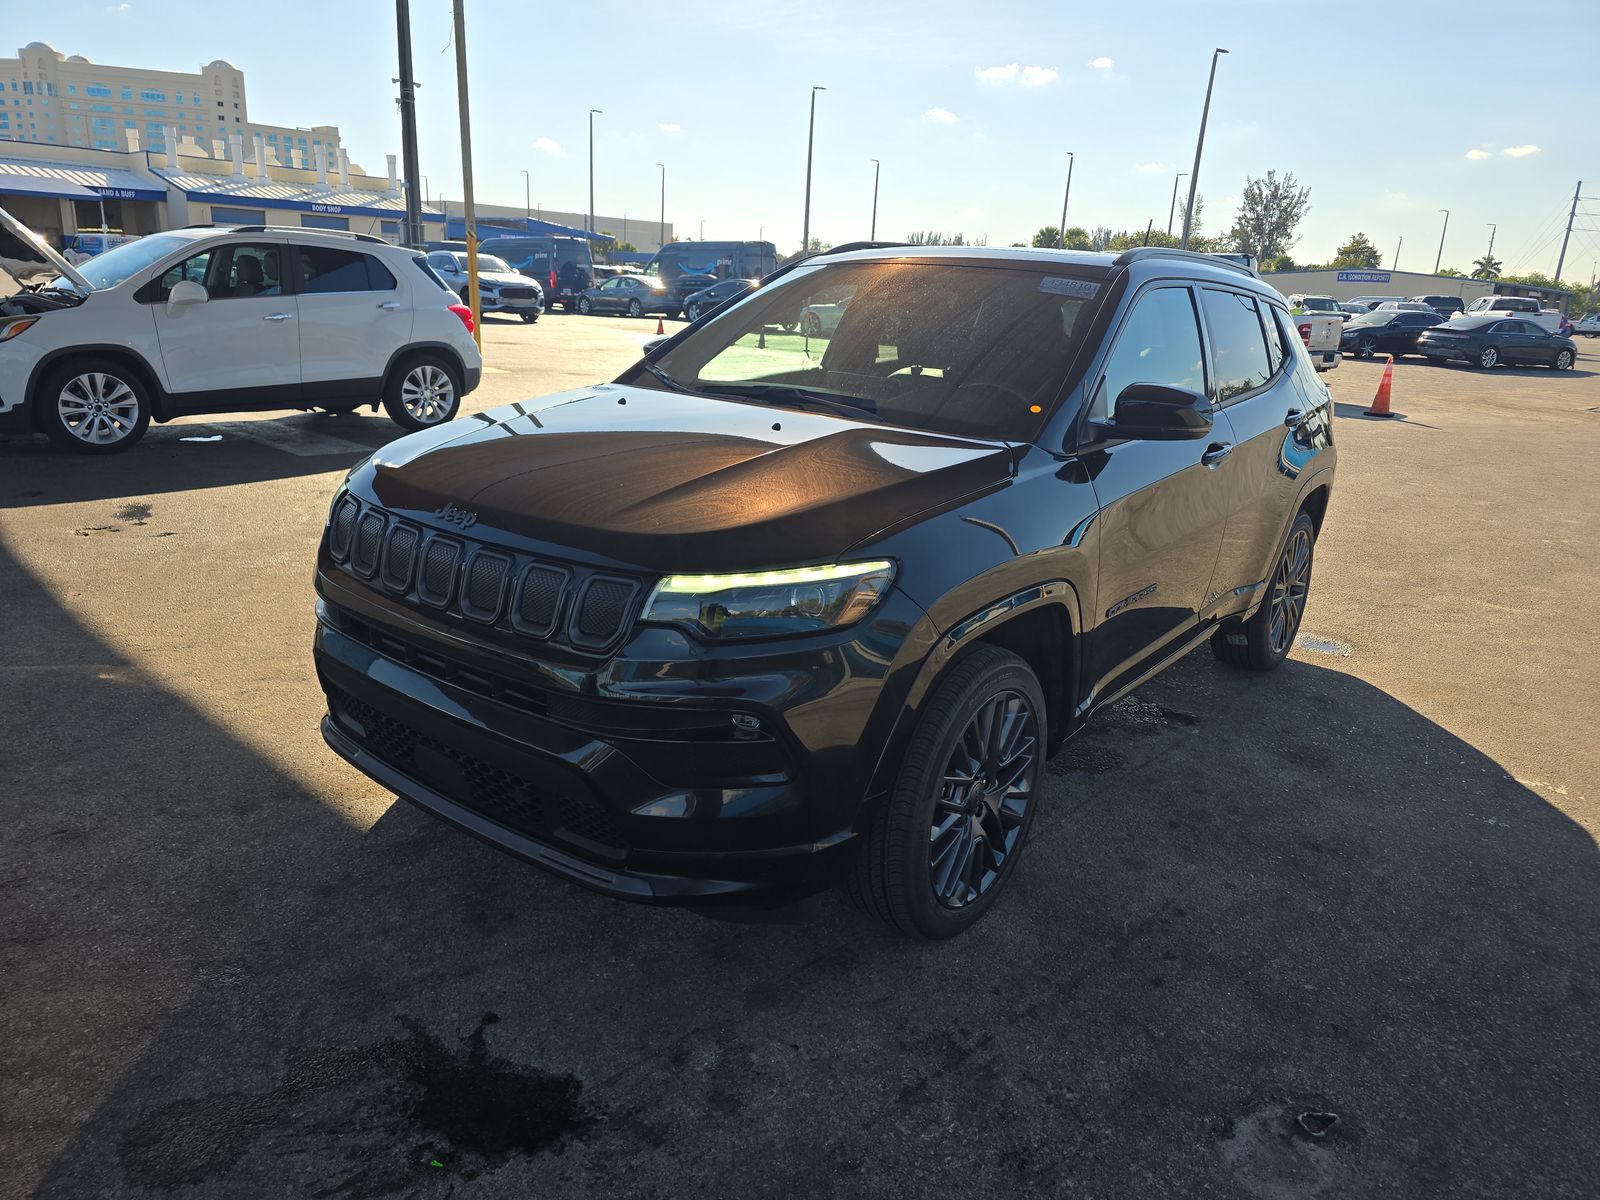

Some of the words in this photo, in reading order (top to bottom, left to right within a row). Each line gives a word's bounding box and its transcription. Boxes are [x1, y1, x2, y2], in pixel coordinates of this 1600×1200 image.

[121, 190, 136, 198] BUFF
[311, 204, 327, 212] BODY
[327, 205, 342, 214] SHOP
[716, 257, 732, 266] prime
[434, 502, 478, 529] Jeep
